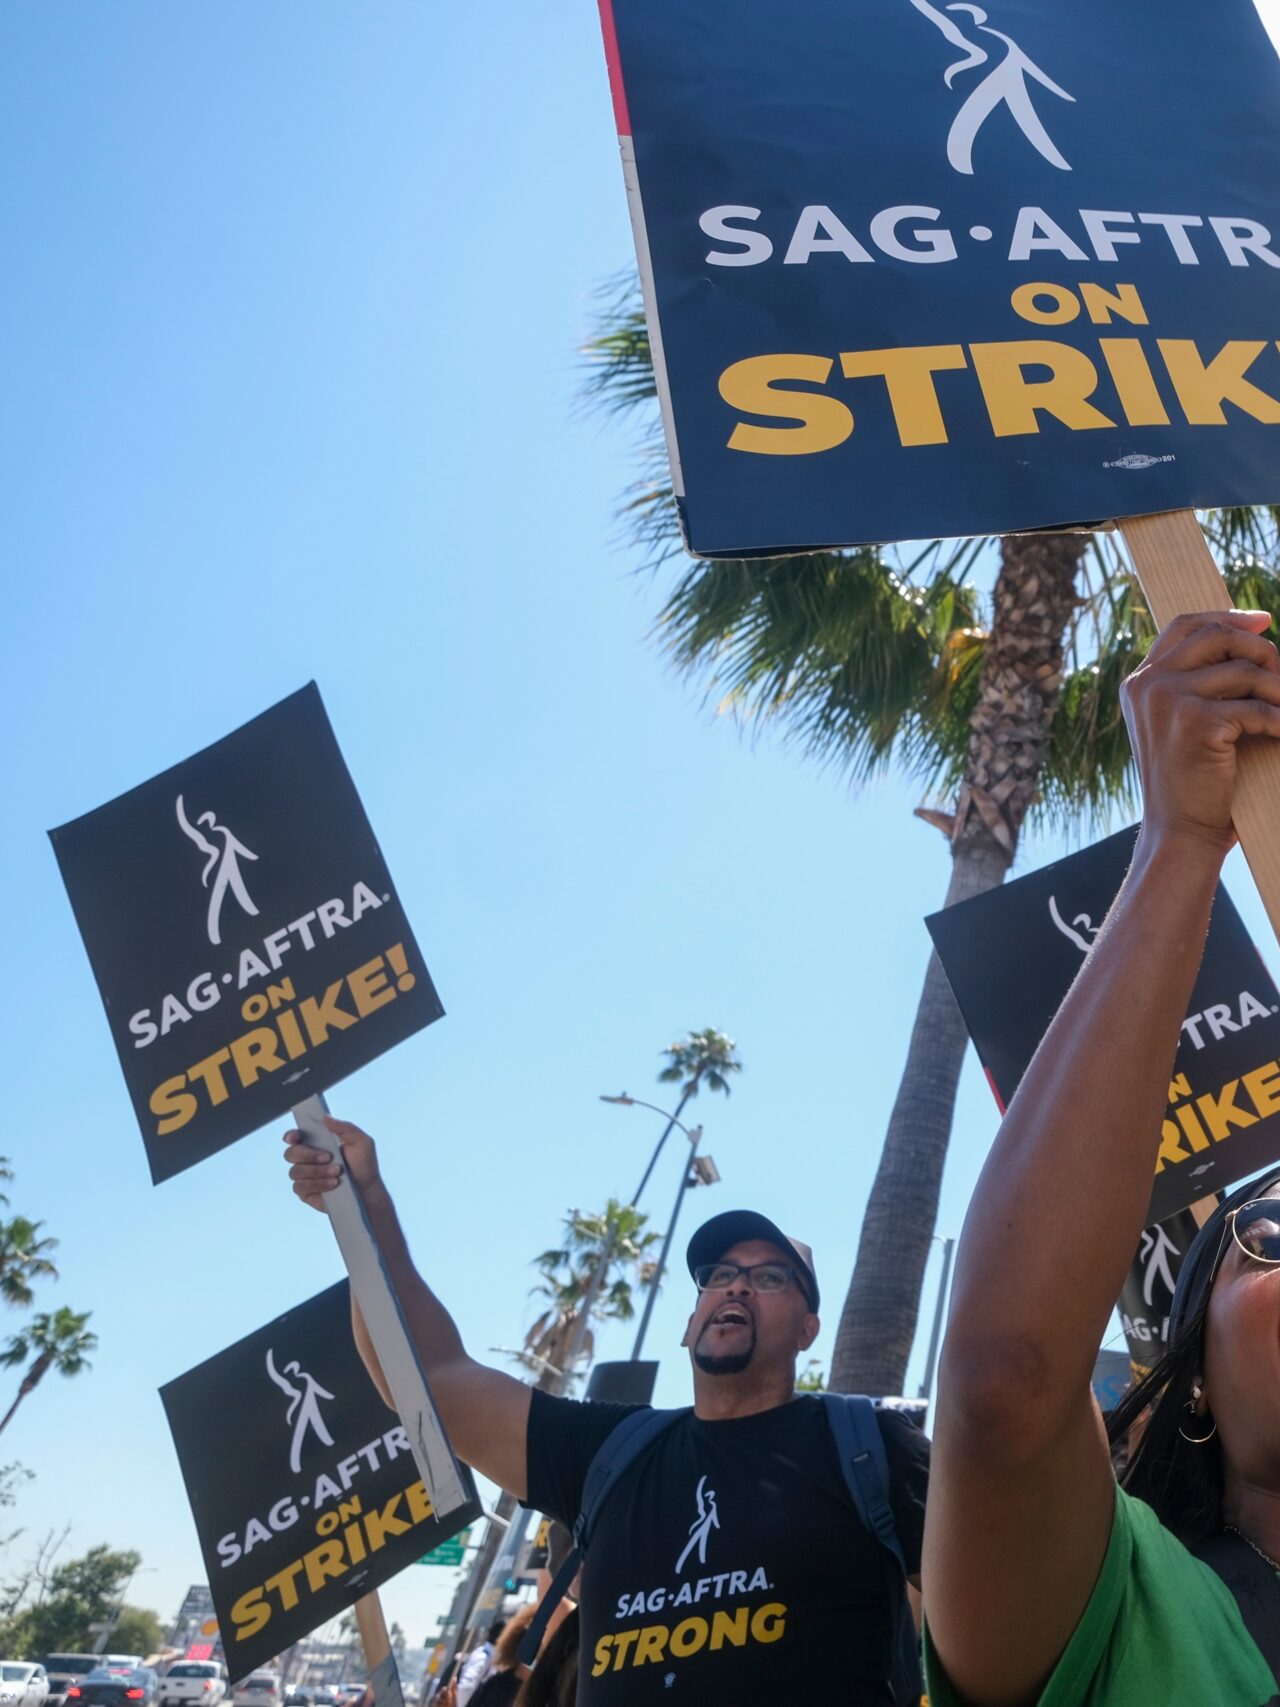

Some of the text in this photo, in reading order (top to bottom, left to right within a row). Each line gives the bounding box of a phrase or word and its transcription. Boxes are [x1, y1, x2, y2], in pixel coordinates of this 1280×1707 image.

[1010, 281, 1148, 325] ON
[240, 976, 296, 1023] ON
[148, 942, 417, 1136] STRIKE!
[216, 1425, 414, 1569] SAG·AFTR
[315, 1494, 363, 1537] ON
[230, 1478, 436, 1643] STRIKE
[590, 1602, 788, 1678] STRONG
